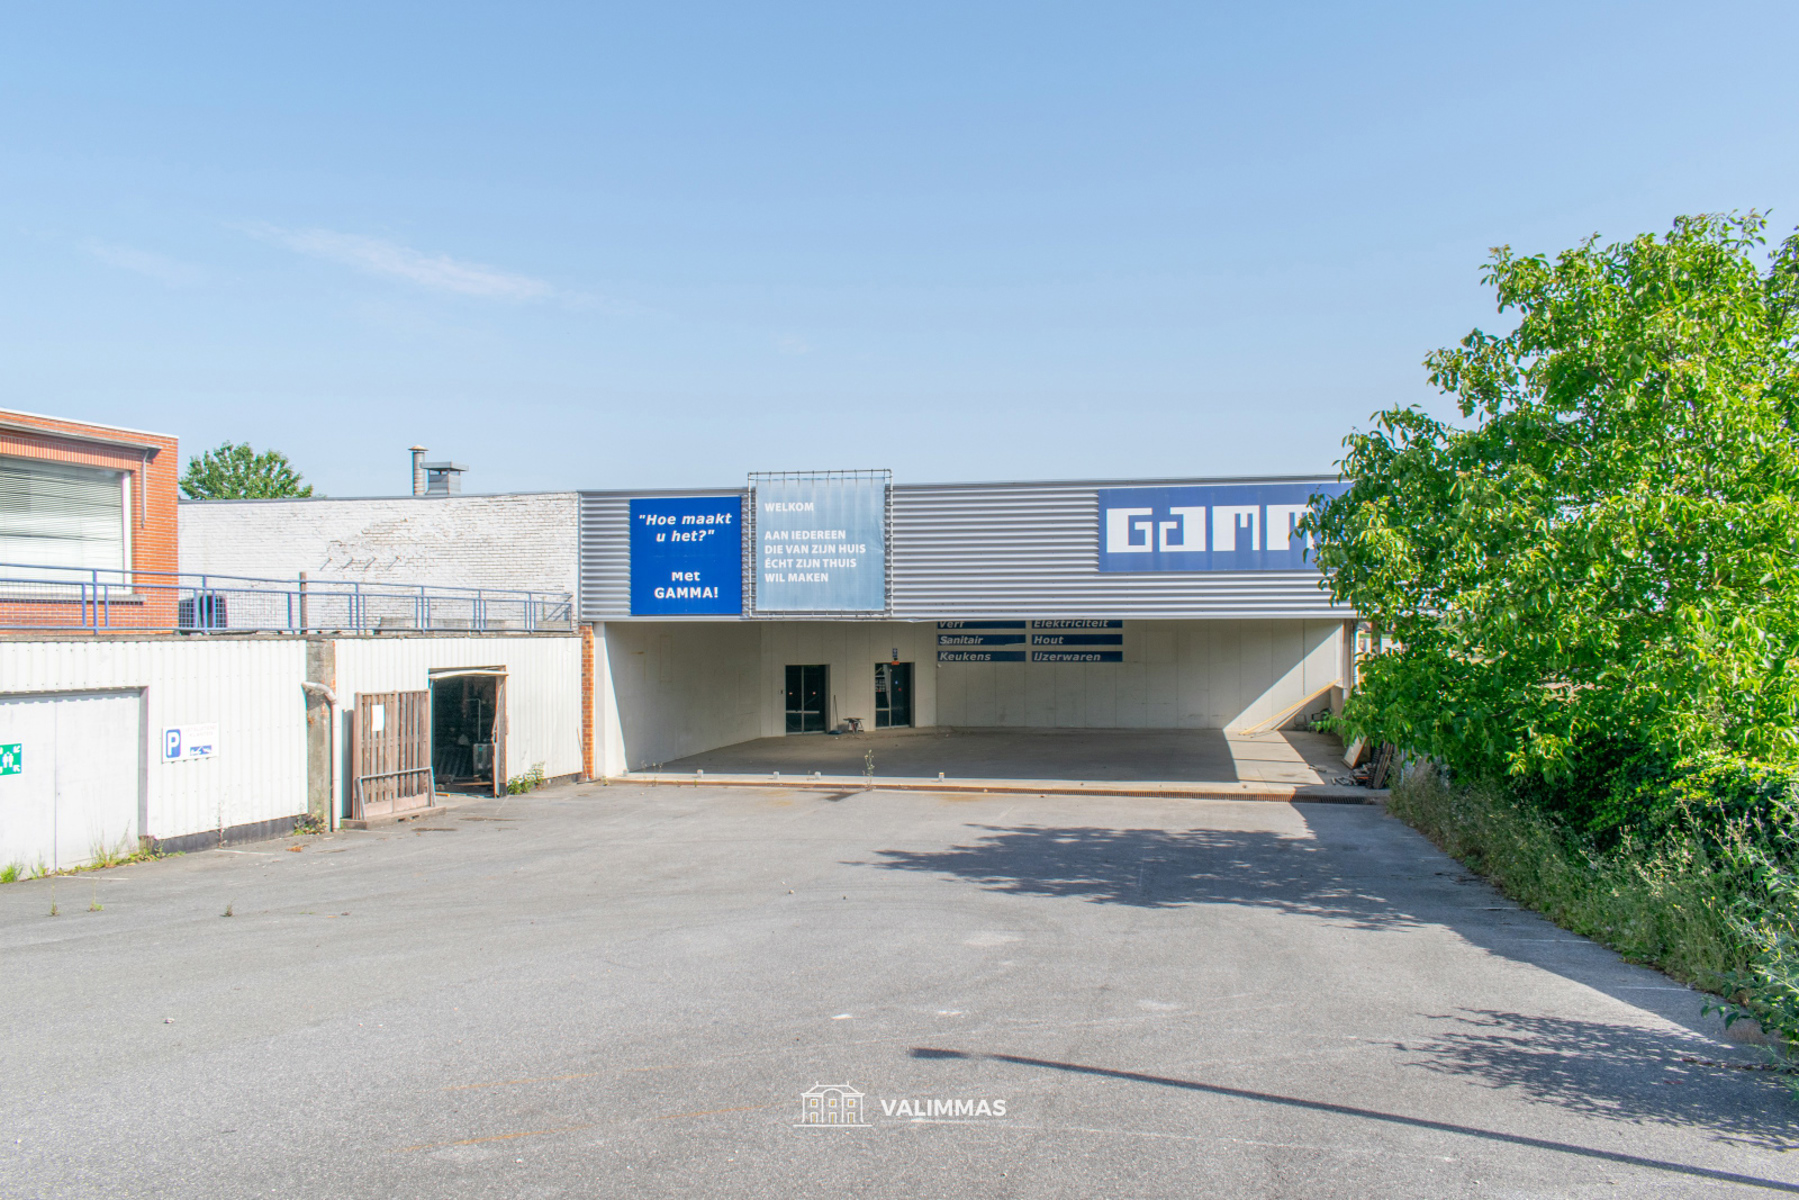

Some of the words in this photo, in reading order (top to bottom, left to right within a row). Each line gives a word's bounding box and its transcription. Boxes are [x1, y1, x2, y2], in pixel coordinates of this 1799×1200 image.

[764, 502, 815, 512] WELKOM
[638, 514, 677, 526] "Hoe
[681, 512, 733, 525] maakt
[656, 533, 666, 543] u
[671, 529, 716, 542] het?"
[764, 531, 788, 541] AAN
[791, 530, 847, 540] IEDEREEN
[764, 545, 783, 554] DIE
[785, 544, 810, 554] VAN
[811, 544, 837, 554] ZIJN
[838, 543, 867, 554] HUIS
[764, 557, 794, 569] ÉCHT
[796, 558, 822, 568] ZIJN
[822, 558, 858, 568] THUIS
[671, 571, 701, 582] Met
[764, 573, 786, 583] WIL
[787, 573, 829, 583] MAKEN
[654, 587, 719, 599] GAMMA!
[1034, 620, 1109, 628] Elektriciteit
[939, 635, 984, 645] Sanitair
[1033, 635, 1065, 645] Hout
[939, 652, 992, 661] Keukens
[1034, 652, 1102, 662] IJzerwaren
[167, 731, 180, 756] P
